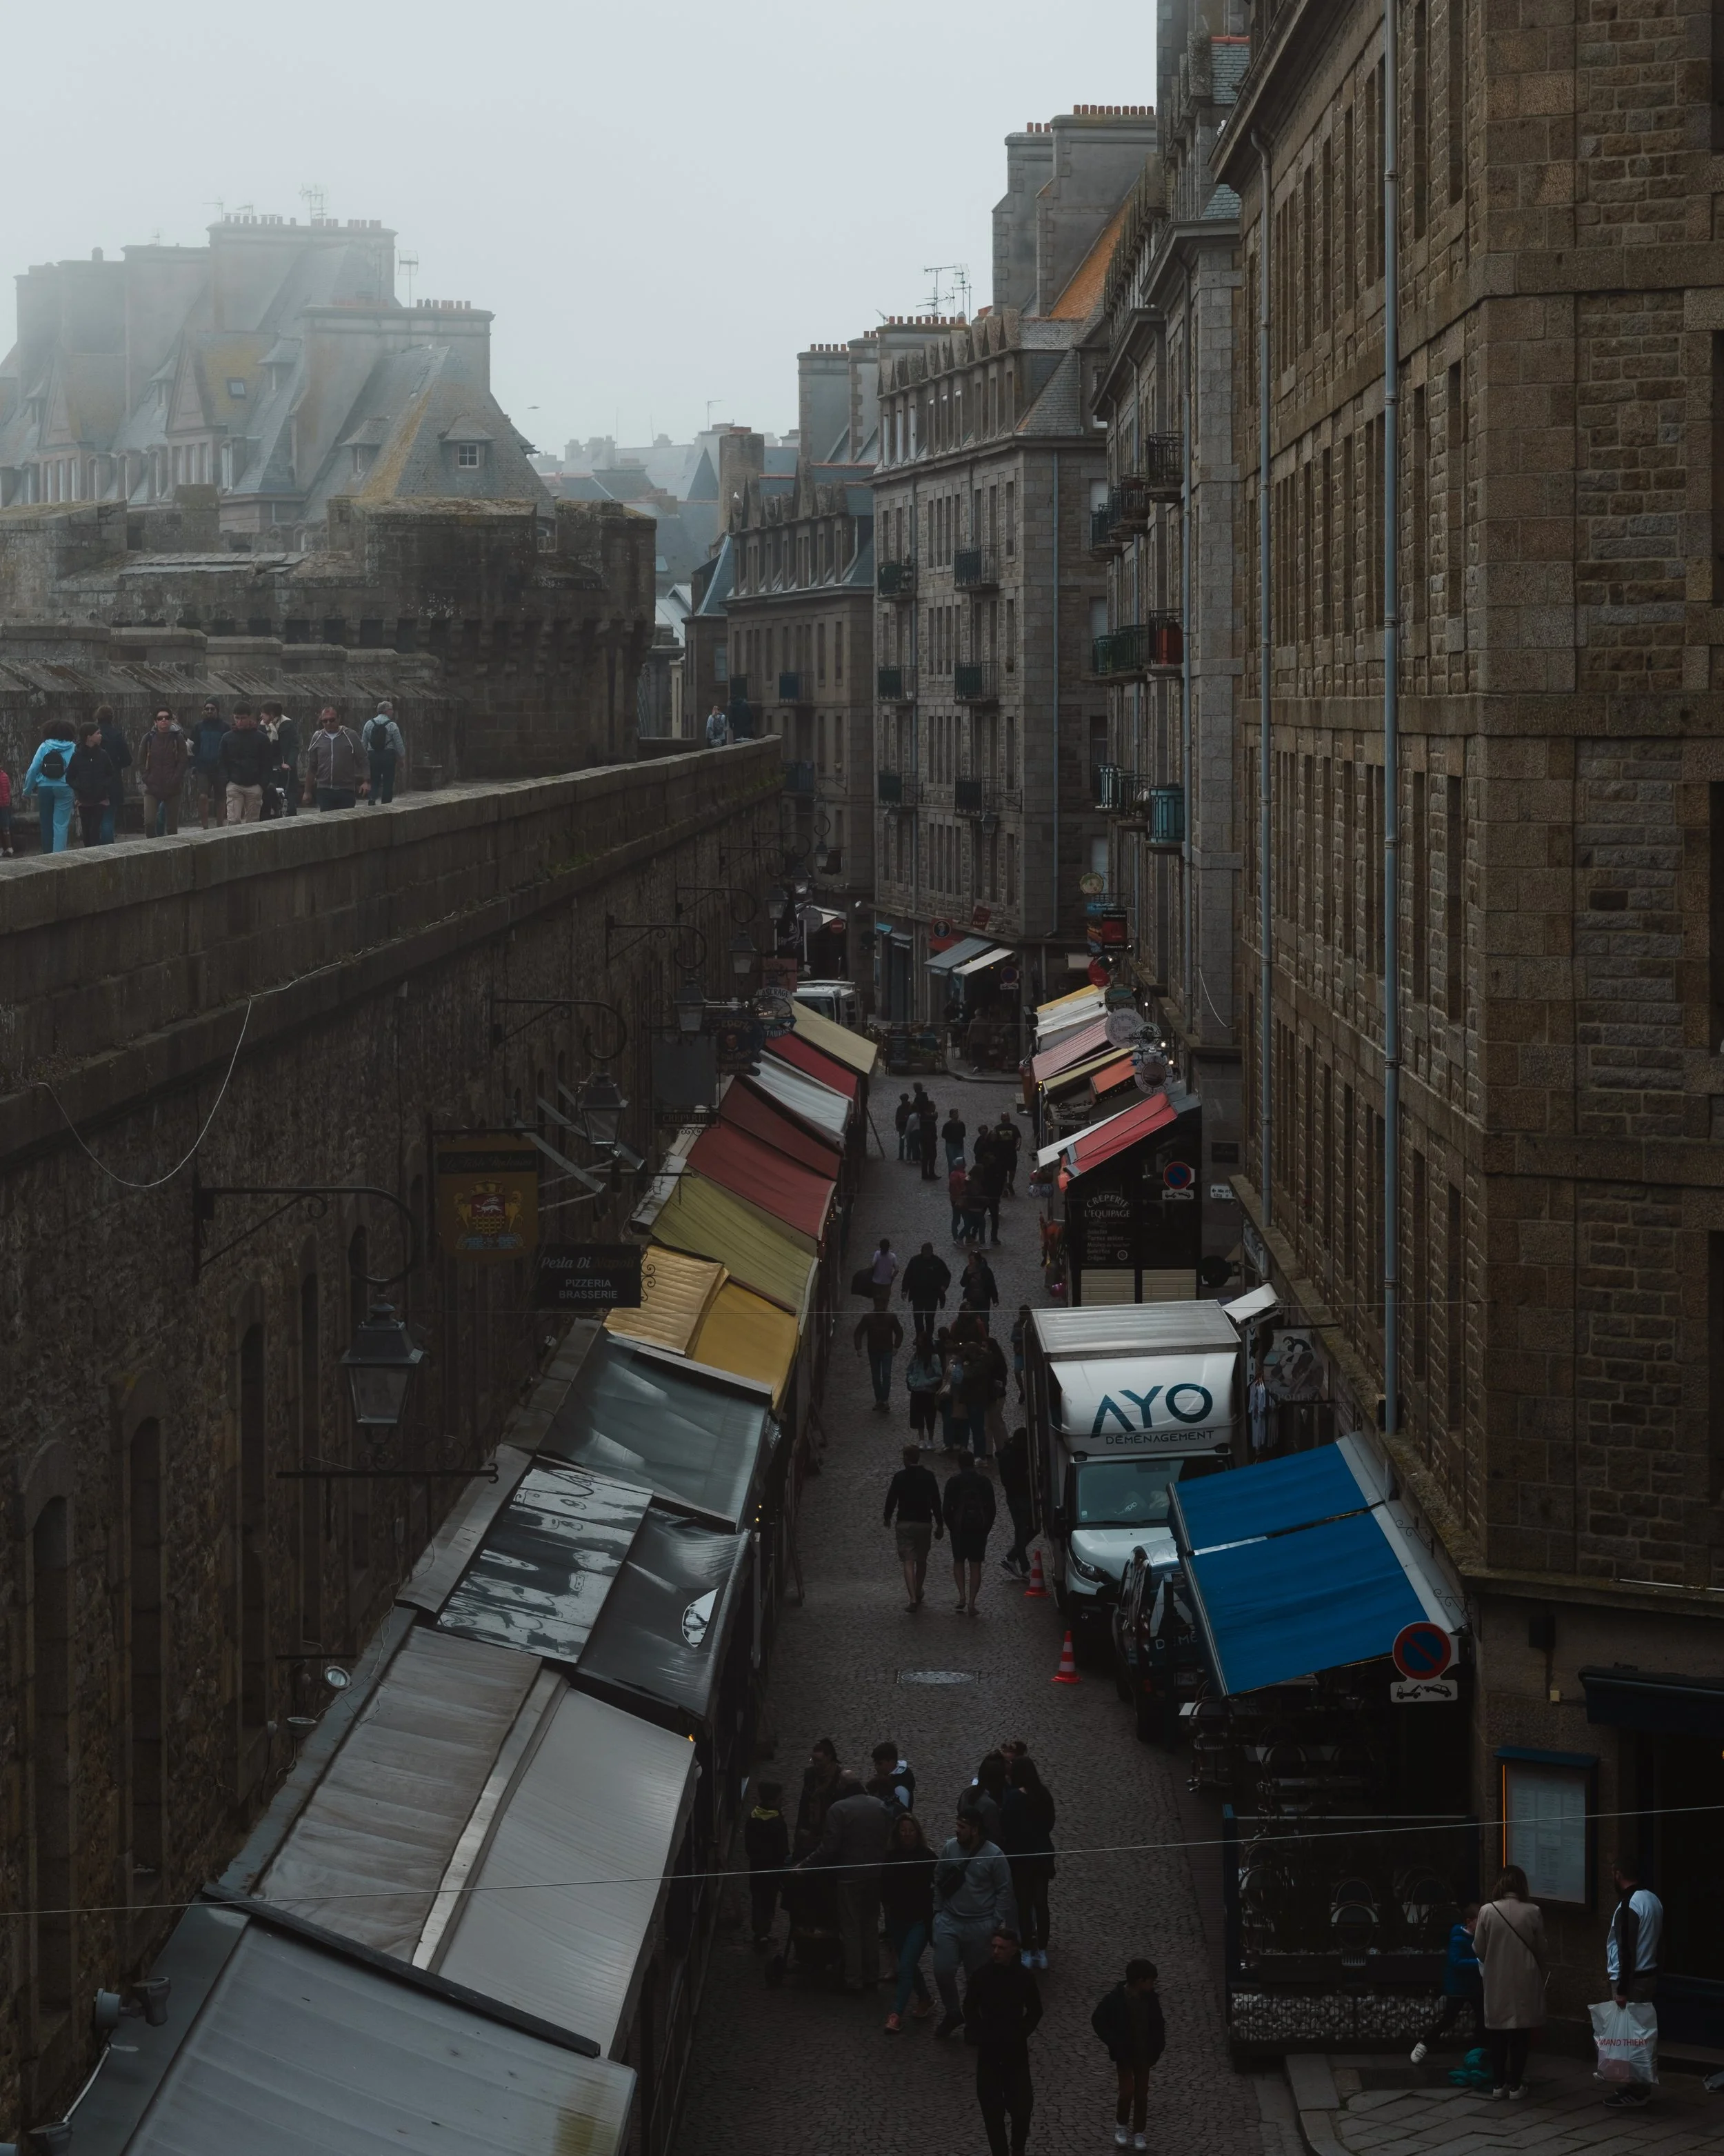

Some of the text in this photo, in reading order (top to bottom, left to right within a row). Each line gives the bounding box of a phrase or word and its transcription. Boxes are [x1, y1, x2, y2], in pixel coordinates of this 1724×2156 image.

[1084, 1209, 1131, 1219] L'EQUIPAGE
[541, 1256, 574, 1269] Perla
[576, 1256, 592, 1269] Di
[565, 1279, 612, 1288] PIZZERIA
[559, 1290, 619, 1299] BRASSERIE
[1090, 1383, 1212, 1439] AYO
